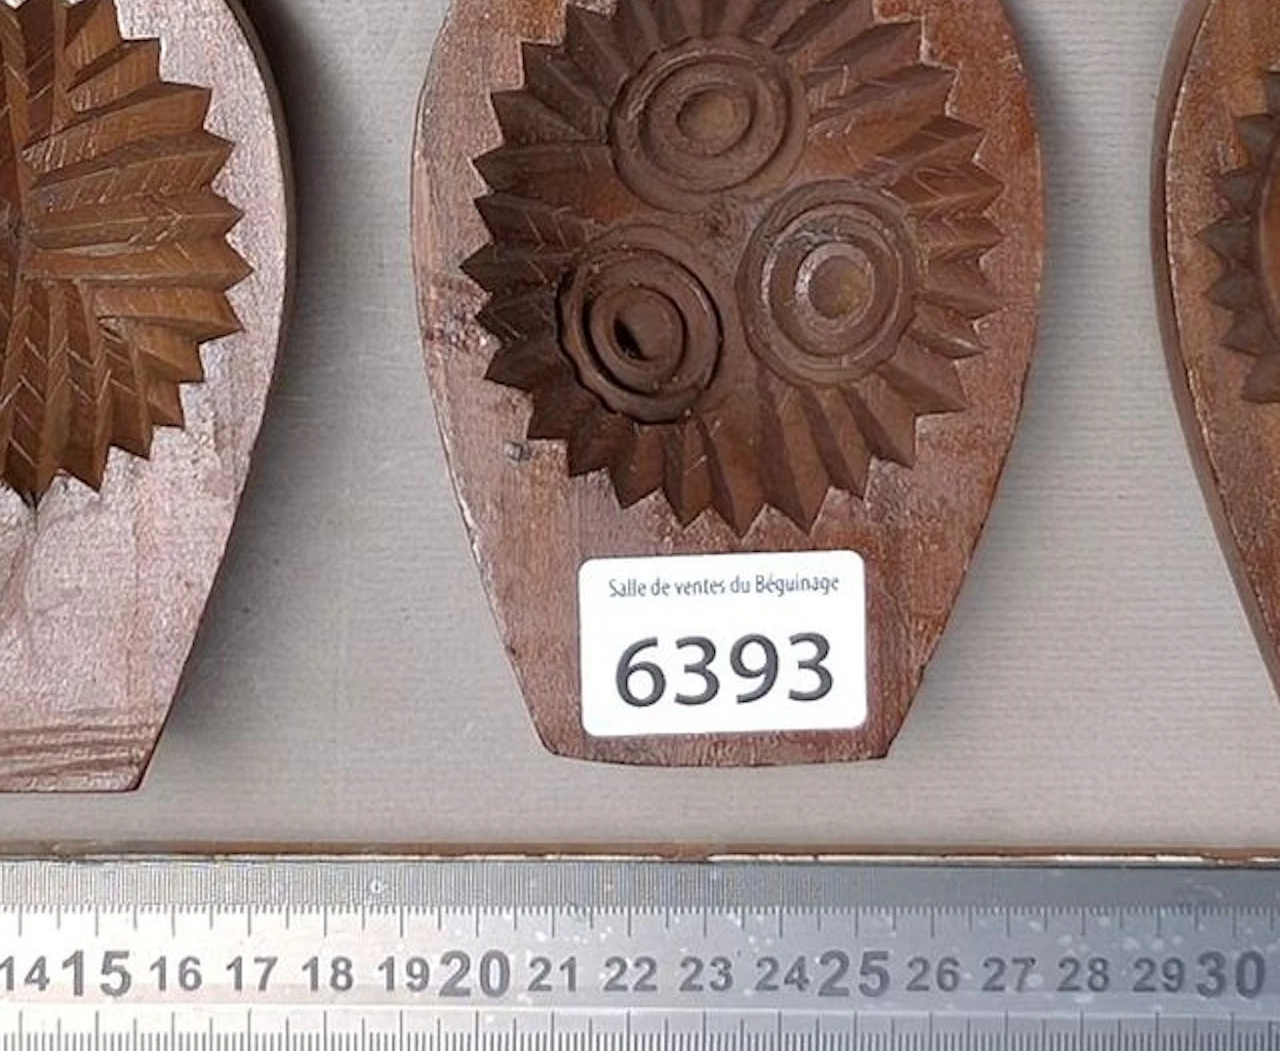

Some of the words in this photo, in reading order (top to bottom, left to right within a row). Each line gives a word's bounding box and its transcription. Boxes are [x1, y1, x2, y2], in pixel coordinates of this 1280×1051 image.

[609, 577, 647, 598] Salle
[650, 577, 671, 597] de
[674, 577, 726, 596] ventes
[729, 575, 750, 595] du
[754, 573, 840, 596] Béguinage
[615, 631, 834, 708] 6393
[61, 949, 133, 1001] 15
[149, 954, 203, 993] 16
[225, 954, 279, 995] 17
[301, 955, 355, 994] 18
[377, 955, 431, 994] 19
[438, 949, 511, 1000] 20
[526, 955, 578, 995] 21
[602, 955, 659, 995] 22
[678, 955, 734, 994] 23
[754, 955, 810, 995] 24
[817, 949, 891, 999] 25
[905, 956, 961, 993] 26
[981, 956, 1037, 993] 27
[1055, 956, 1111, 993] 28
[1131, 956, 1186, 994] 29
[1196, 950, 1266, 999] 30
